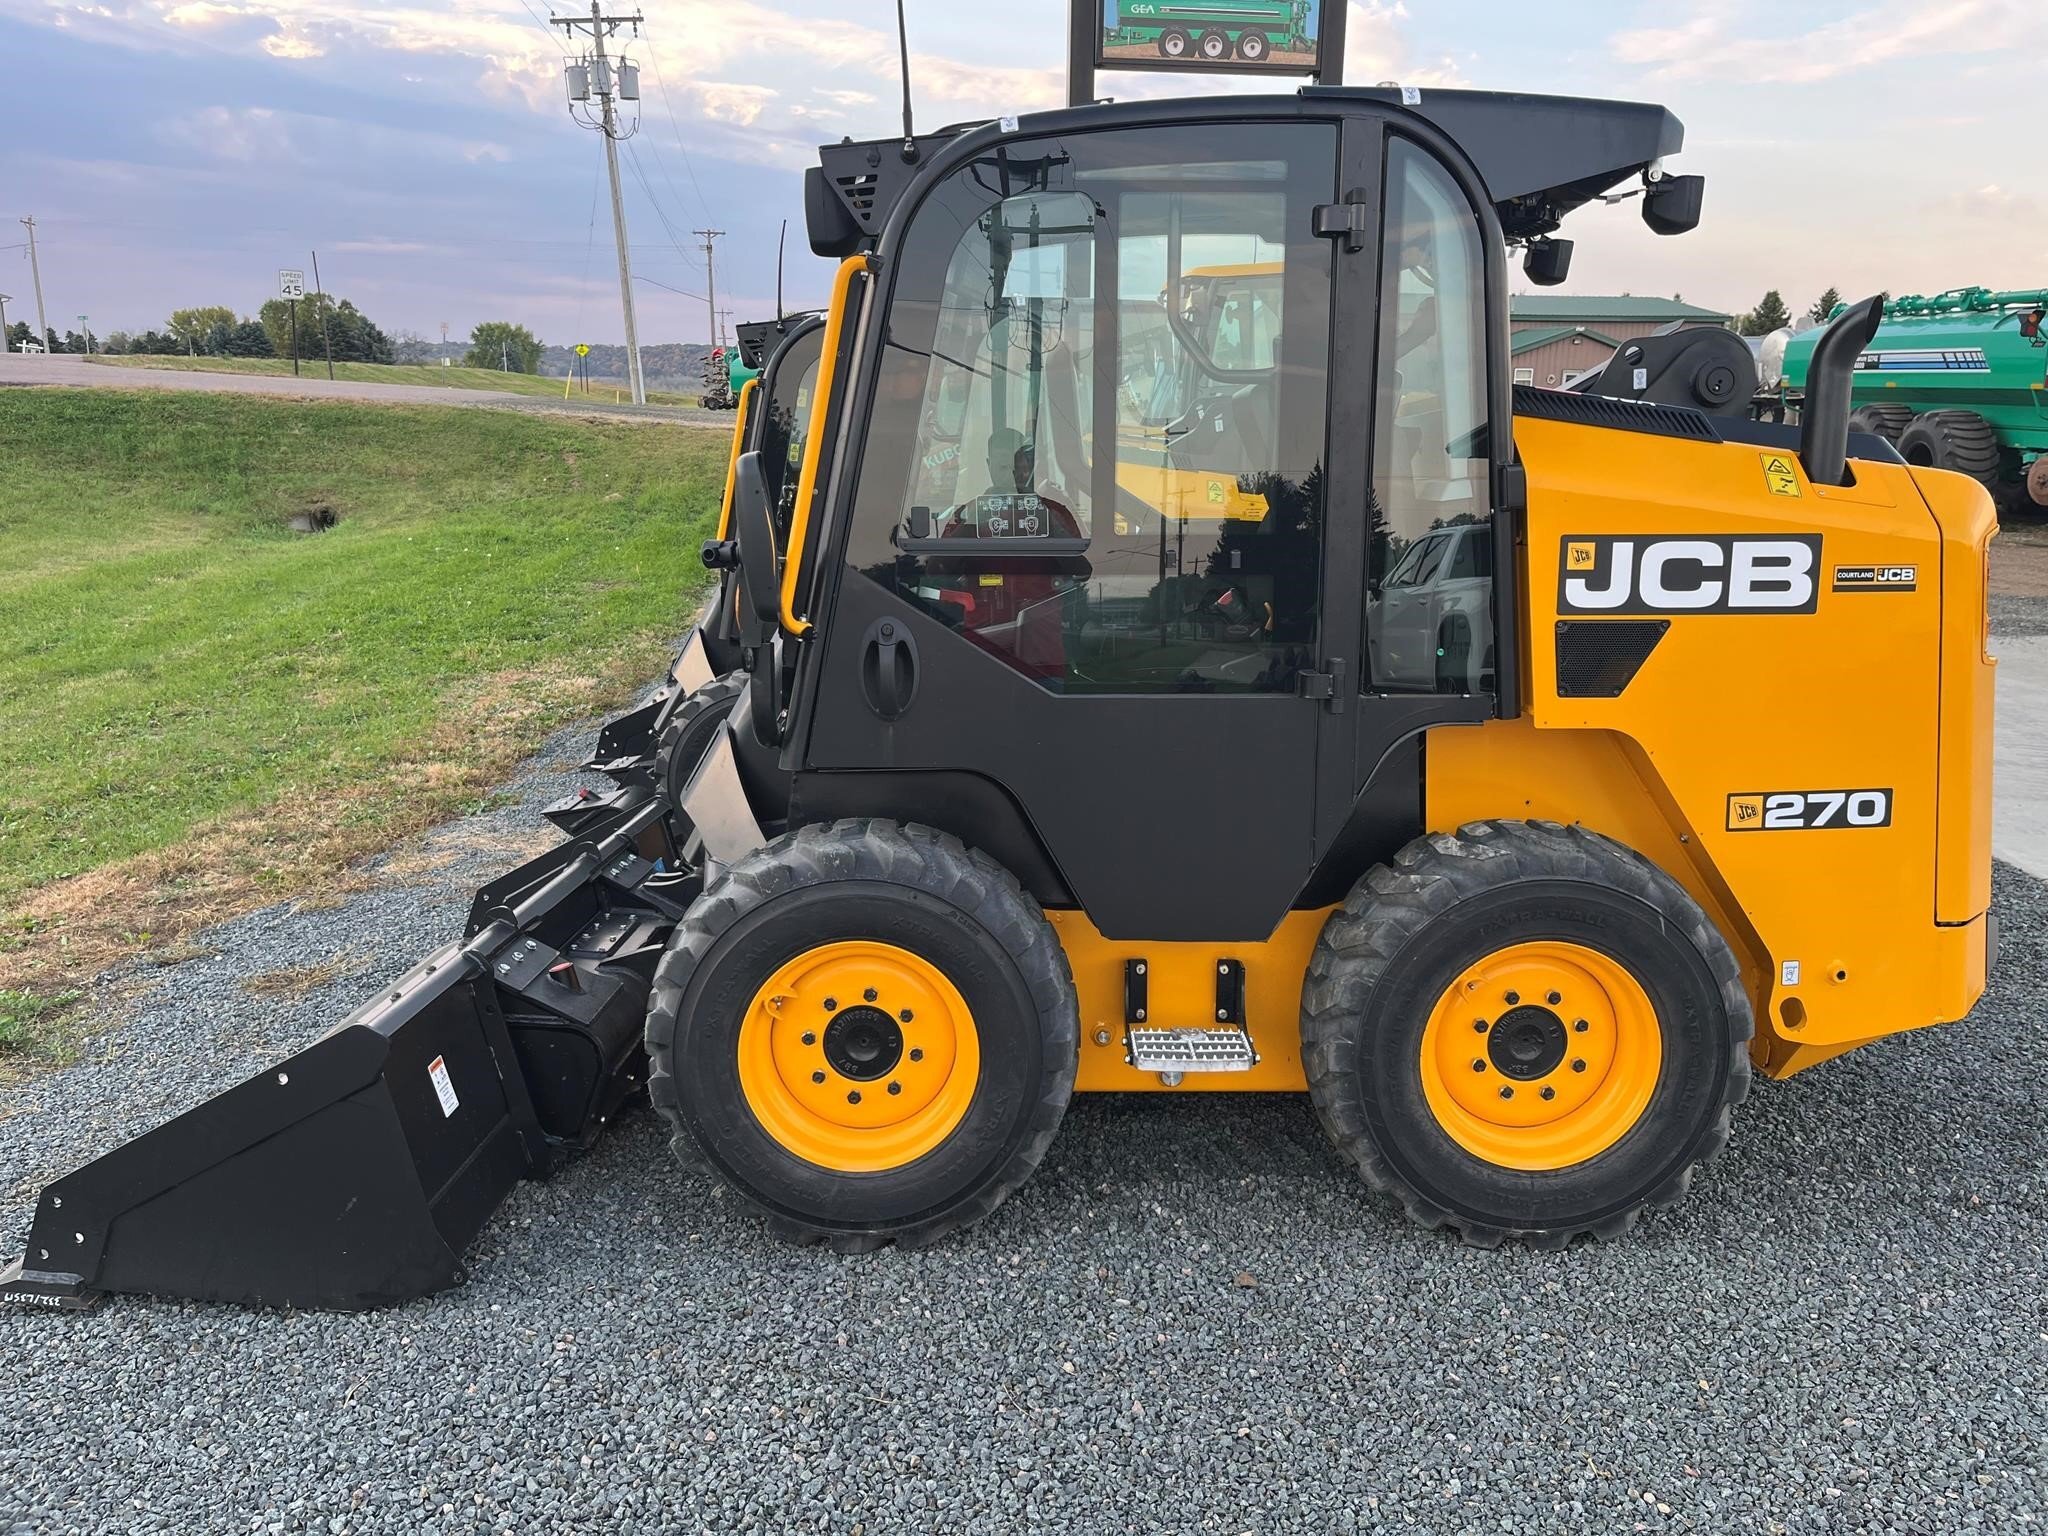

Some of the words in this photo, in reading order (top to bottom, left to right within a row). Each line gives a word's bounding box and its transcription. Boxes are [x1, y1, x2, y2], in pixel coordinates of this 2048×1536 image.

[1131, 4, 1155, 14] GEA
[282, 285, 302, 297] 45
[1574, 550, 1590, 563] JCB
[1565, 541, 1812, 608] JCB
[1837, 571, 1874, 579] COURTLAND
[1877, 568, 1914, 581] JCB
[1738, 804, 1757, 820] JCB
[1765, 792, 1886, 828] 270
